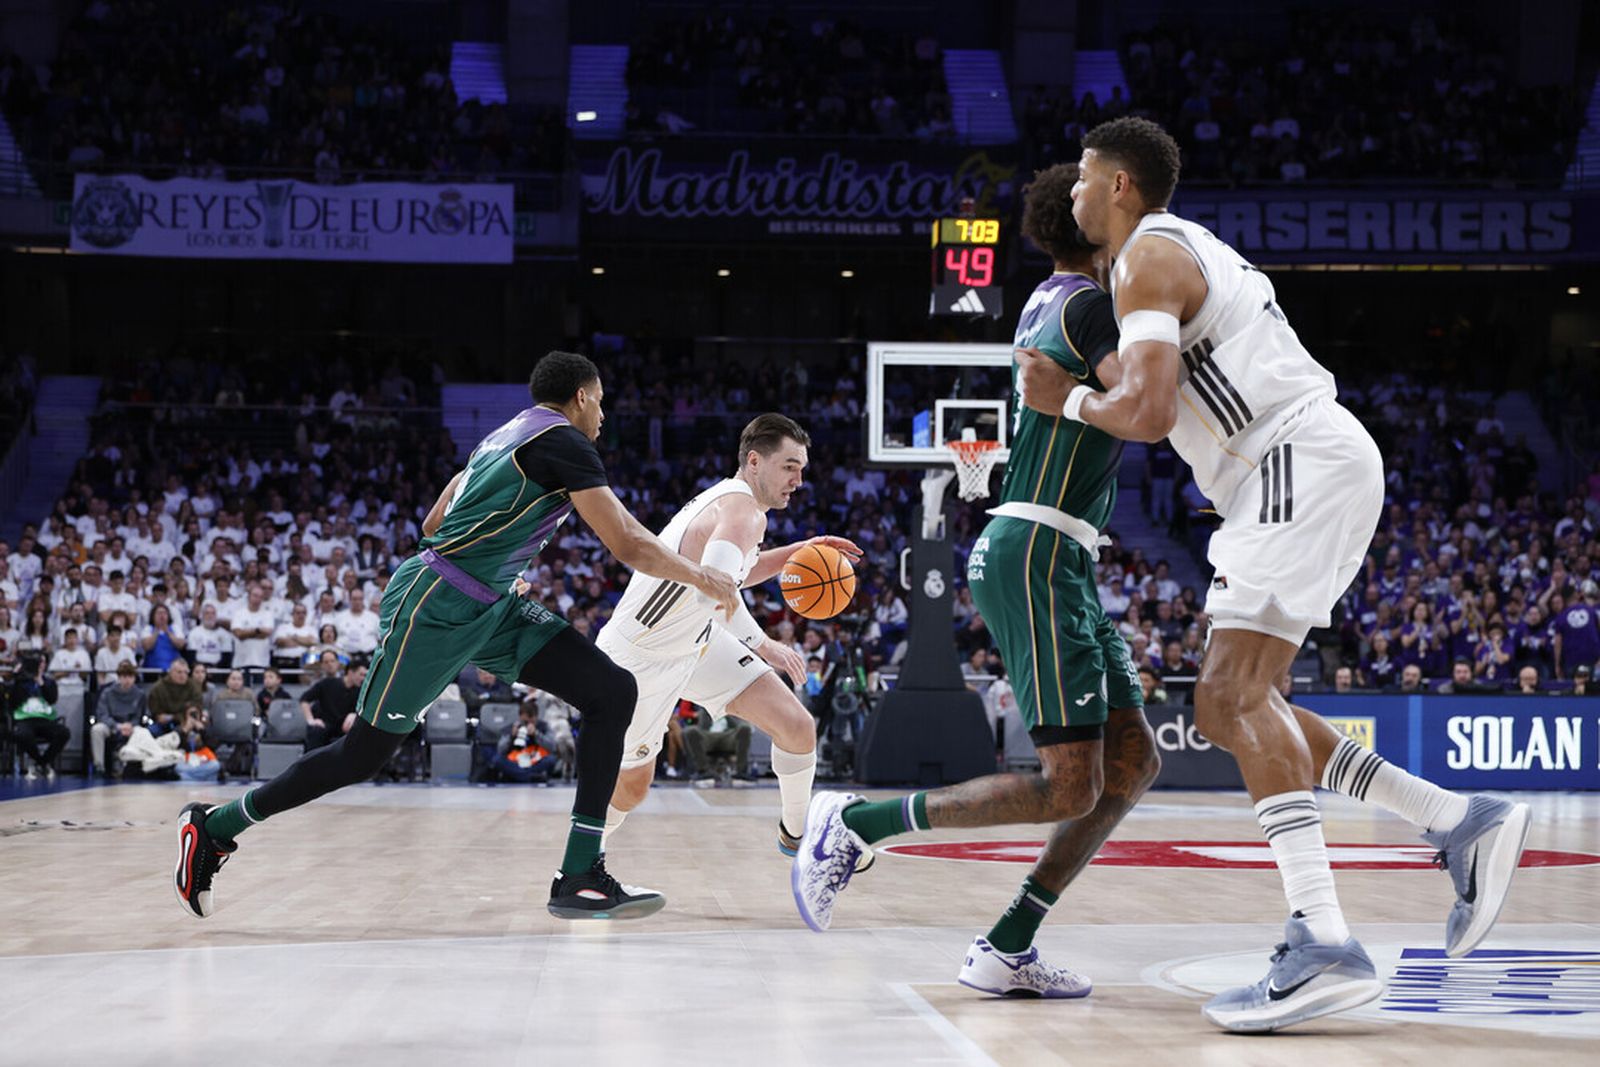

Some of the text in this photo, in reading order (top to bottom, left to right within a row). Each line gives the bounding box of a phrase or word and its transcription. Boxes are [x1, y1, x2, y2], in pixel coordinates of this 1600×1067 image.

[138, 193, 262, 230] REYES
[289, 195, 340, 232] DE
[186, 232, 214, 247] LOS
[289, 234, 317, 249] DEL
[324, 234, 371, 250] TIGRE
[1446, 715, 1583, 771] SOLAN
